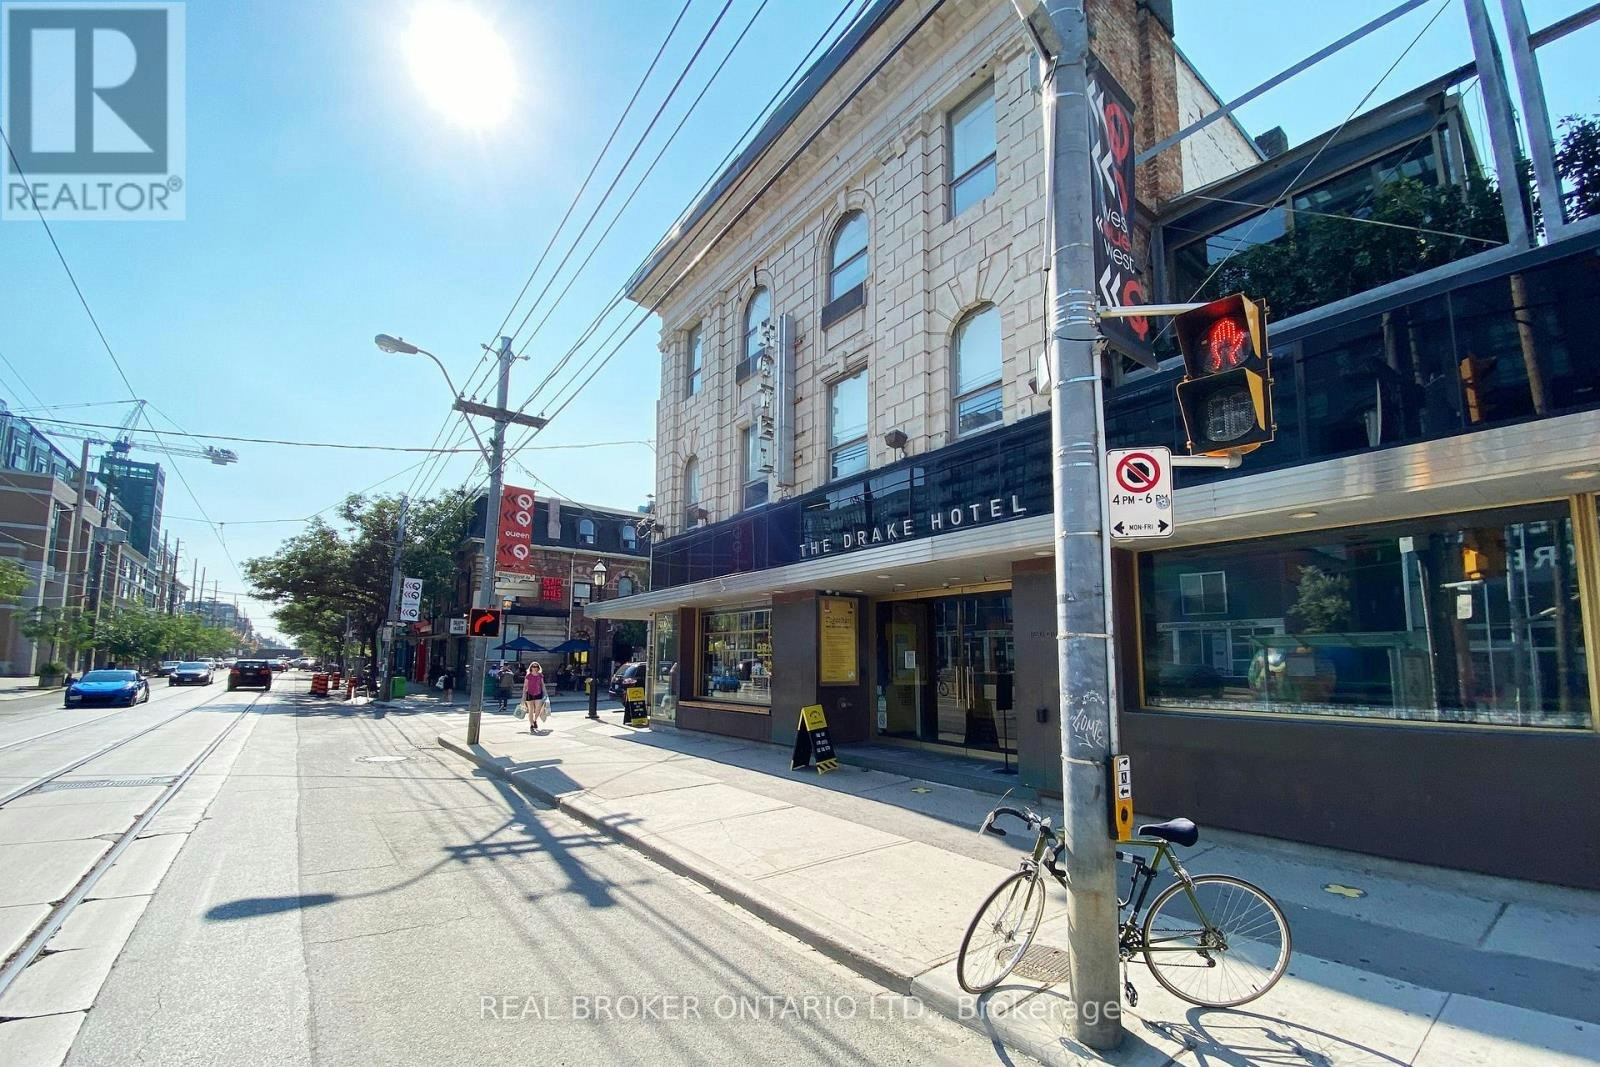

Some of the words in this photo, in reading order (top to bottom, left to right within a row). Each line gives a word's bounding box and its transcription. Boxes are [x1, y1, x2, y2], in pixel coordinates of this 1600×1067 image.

[1103, 238, 1135, 275] west
[1112, 494, 1121, 506] 4
[1122, 495, 1135, 505] PM
[1145, 492, 1153, 504] 6
[799, 538, 831, 558] THE
[843, 519, 914, 550] DRAKE
[931, 494, 1028, 531] HOTEL
[1128, 524, 1154, 532] MON-FRI
